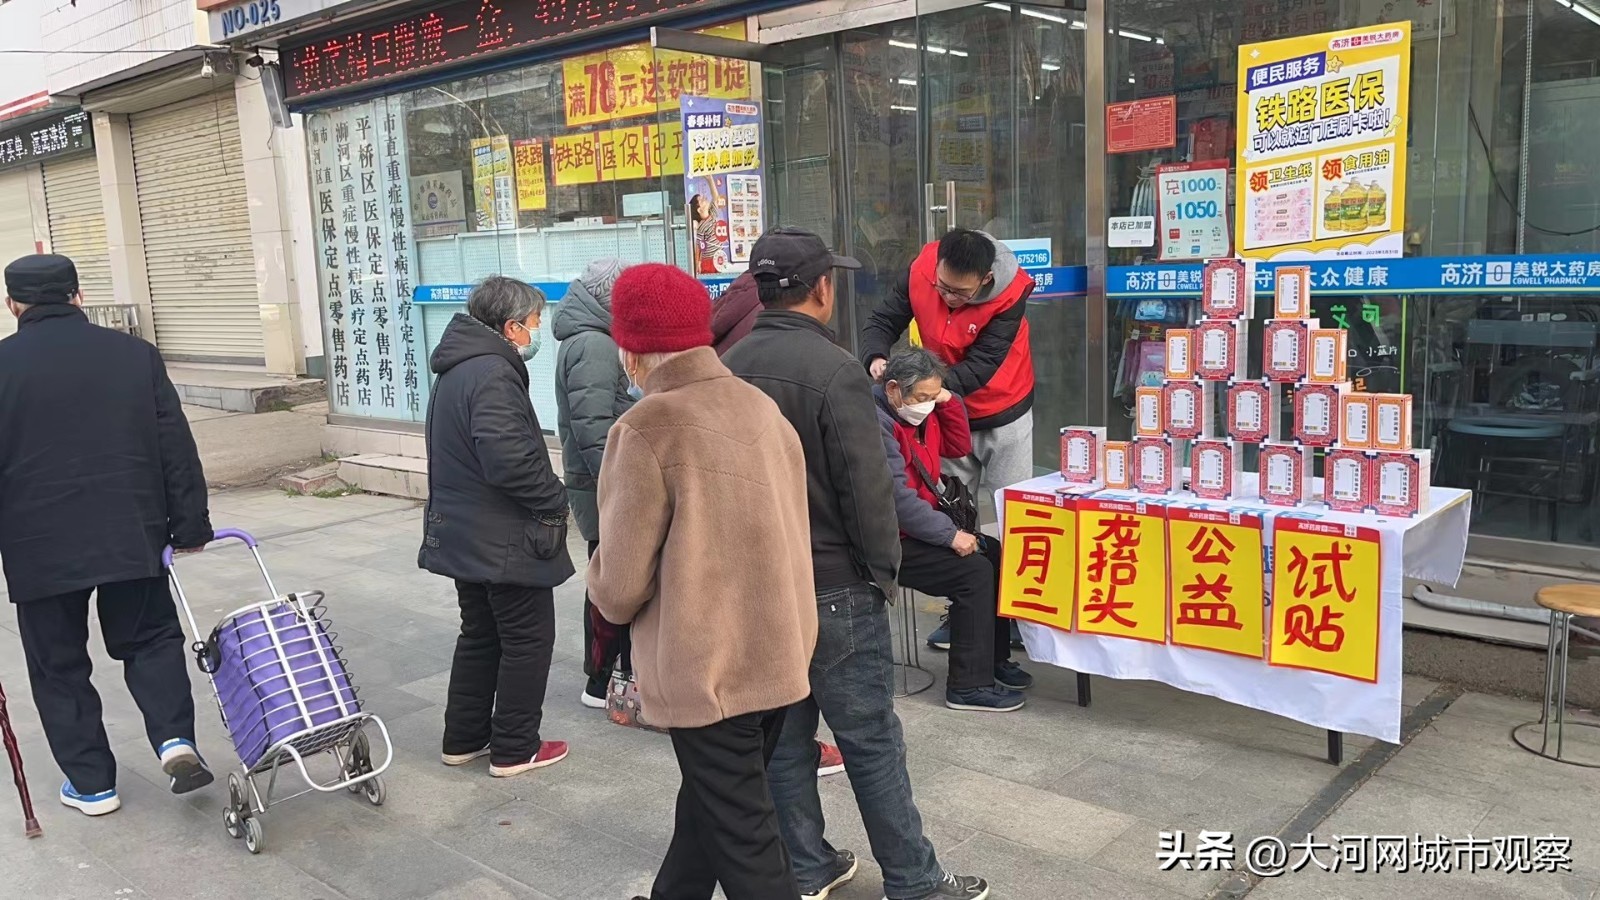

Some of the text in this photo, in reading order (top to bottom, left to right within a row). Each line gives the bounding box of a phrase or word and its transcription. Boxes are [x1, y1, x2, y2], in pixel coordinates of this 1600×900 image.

[1252, 57, 1320, 86] 便民服务
[1256, 70, 1384, 132] 铁路医保
[515, 146, 543, 167] 铁路
[1111, 220, 1152, 231] 本店已加盟
[355, 115, 395, 408] 平桥区医保定点零售药店
[383, 113, 420, 412] 市直重症慢性病医疗定点药店
[1017, 254, 1047, 264] 6752166
[1126, 271, 1156, 290] 高济
[1441, 261, 1600, 285] 高济 美锐大药房
[1544, 276, 1587, 285] PHARMACY
[319, 189, 350, 407] 医保定点零售药店
[1084, 513, 1141, 629] 龙抬头
[1177, 526, 1243, 631] 公益
[1282, 540, 1356, 652] 试贴
